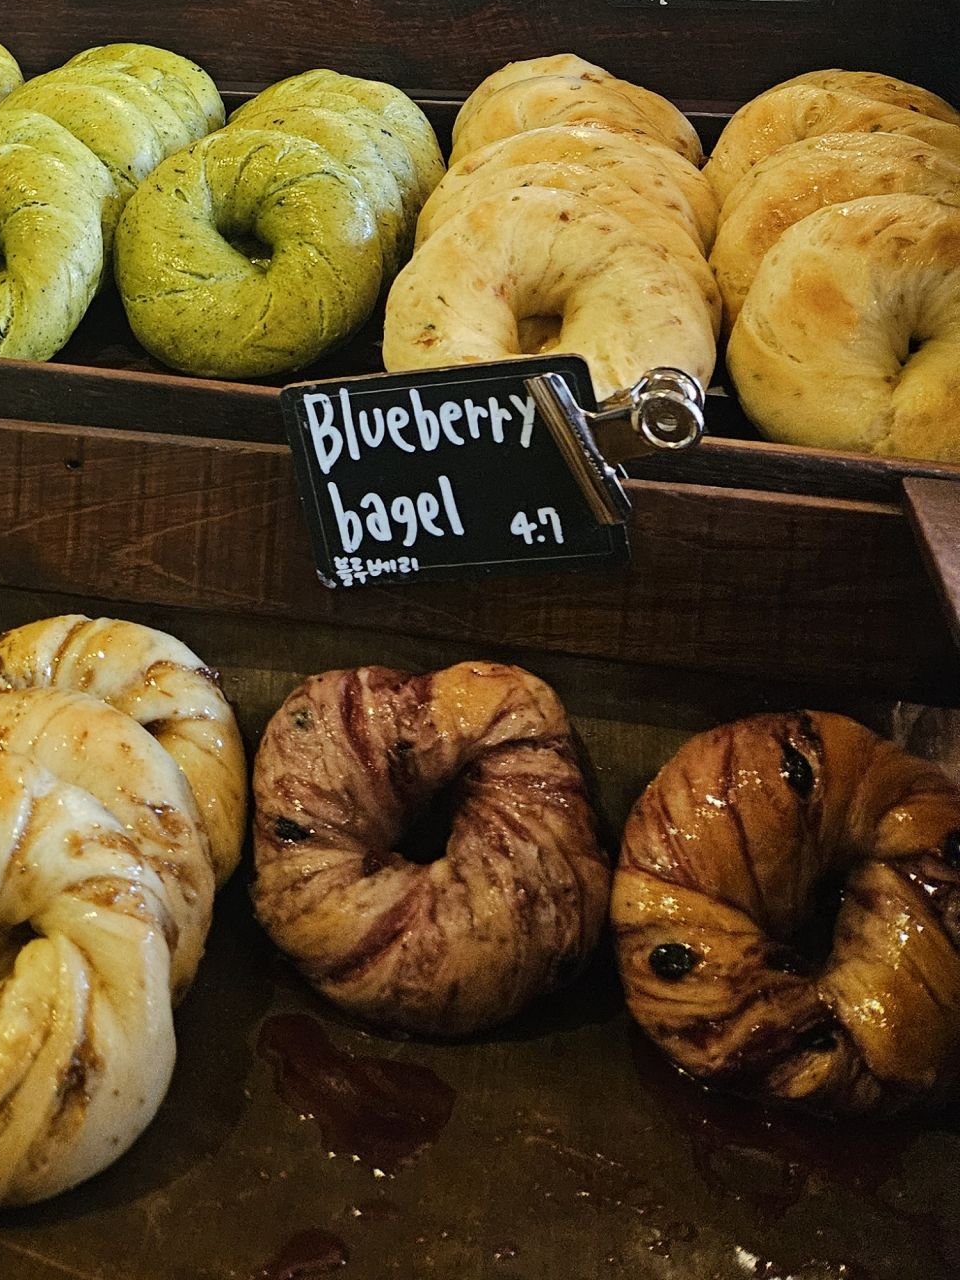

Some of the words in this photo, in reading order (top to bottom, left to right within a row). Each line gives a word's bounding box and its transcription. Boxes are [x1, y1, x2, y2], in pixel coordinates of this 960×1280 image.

[303, 388, 537, 475] Blueberry
[327, 475, 464, 554] bagel
[510, 507, 564, 545] 4.7
[333, 555, 420, 587] 블루베리
